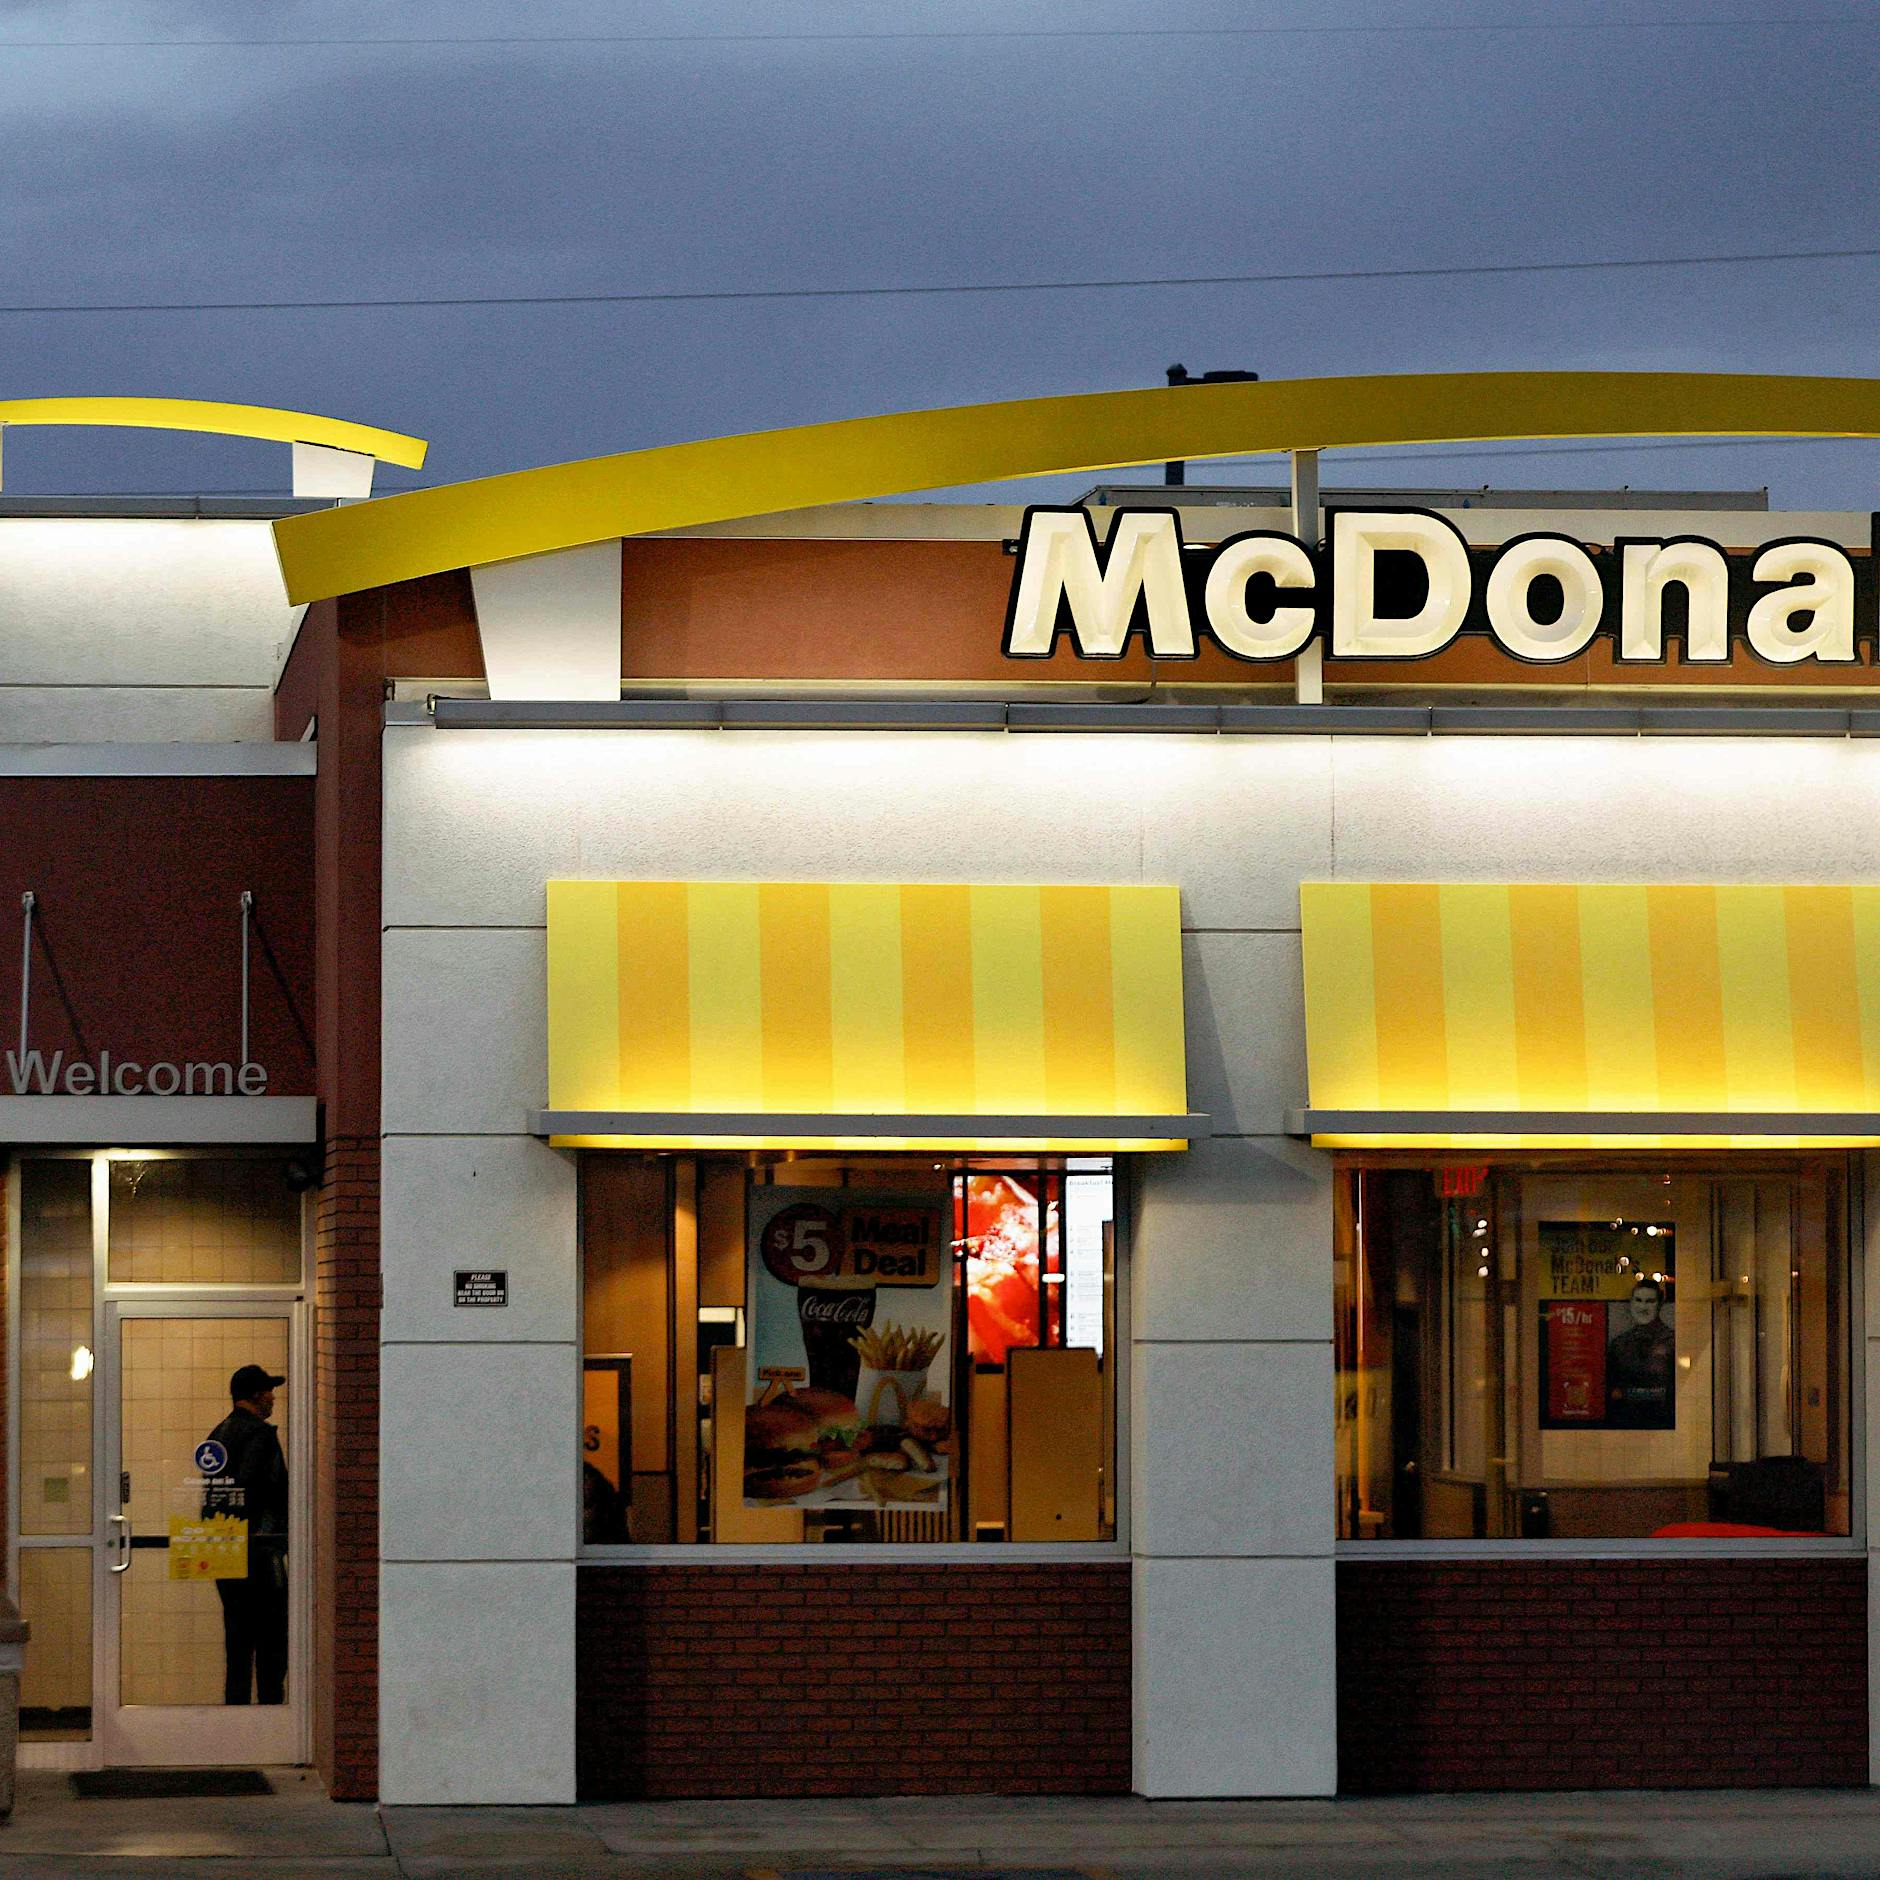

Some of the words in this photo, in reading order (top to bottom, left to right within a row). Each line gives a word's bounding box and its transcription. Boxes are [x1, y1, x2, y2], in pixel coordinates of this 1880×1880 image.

[1004, 505, 1880, 664] McDona
[6, 1050, 268, 1095] Welcome
[773, 1218, 831, 1272] $5
[851, 1216, 930, 1244] Meal
[854, 1248, 927, 1277] Deal
[1552, 1276, 1601, 1295] TEAM!
